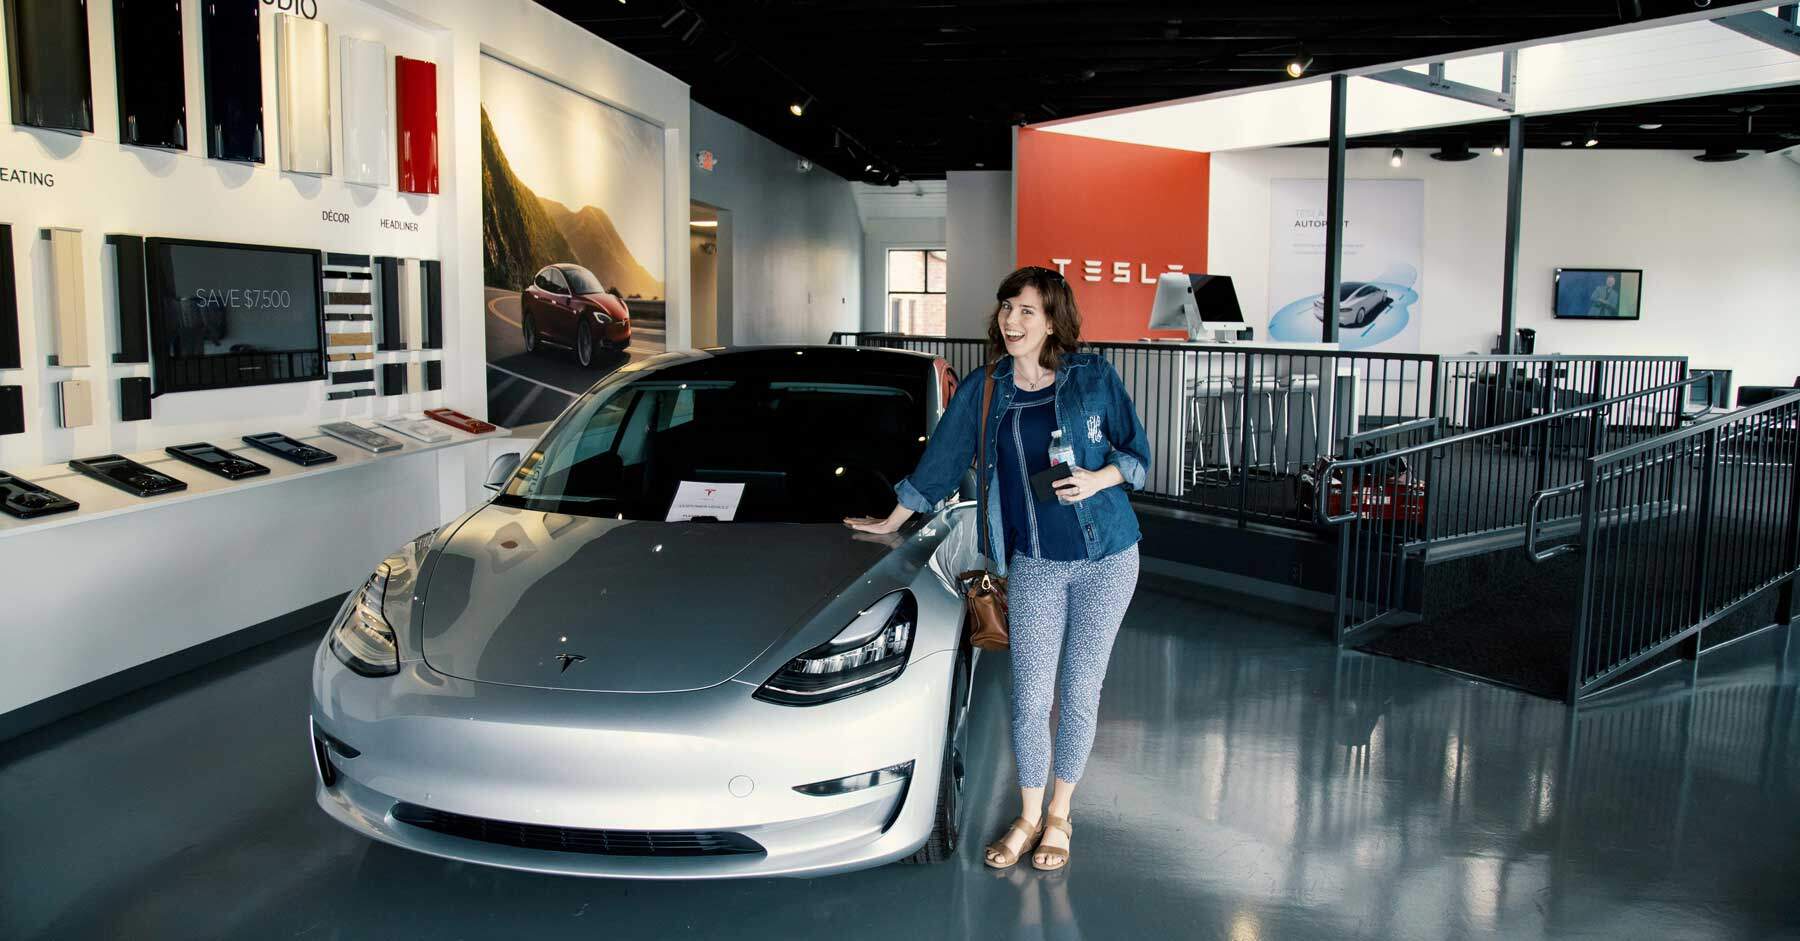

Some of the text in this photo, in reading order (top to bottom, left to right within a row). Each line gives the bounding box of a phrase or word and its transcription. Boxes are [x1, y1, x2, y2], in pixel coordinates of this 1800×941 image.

[322, 209, 350, 223] DÉCOR
[380, 218, 419, 232] HEADLINER
[1294, 220, 1350, 228] AUTOPT
[1052, 258, 1184, 284] TESL
[196, 288, 291, 309] SAVE $7,500
